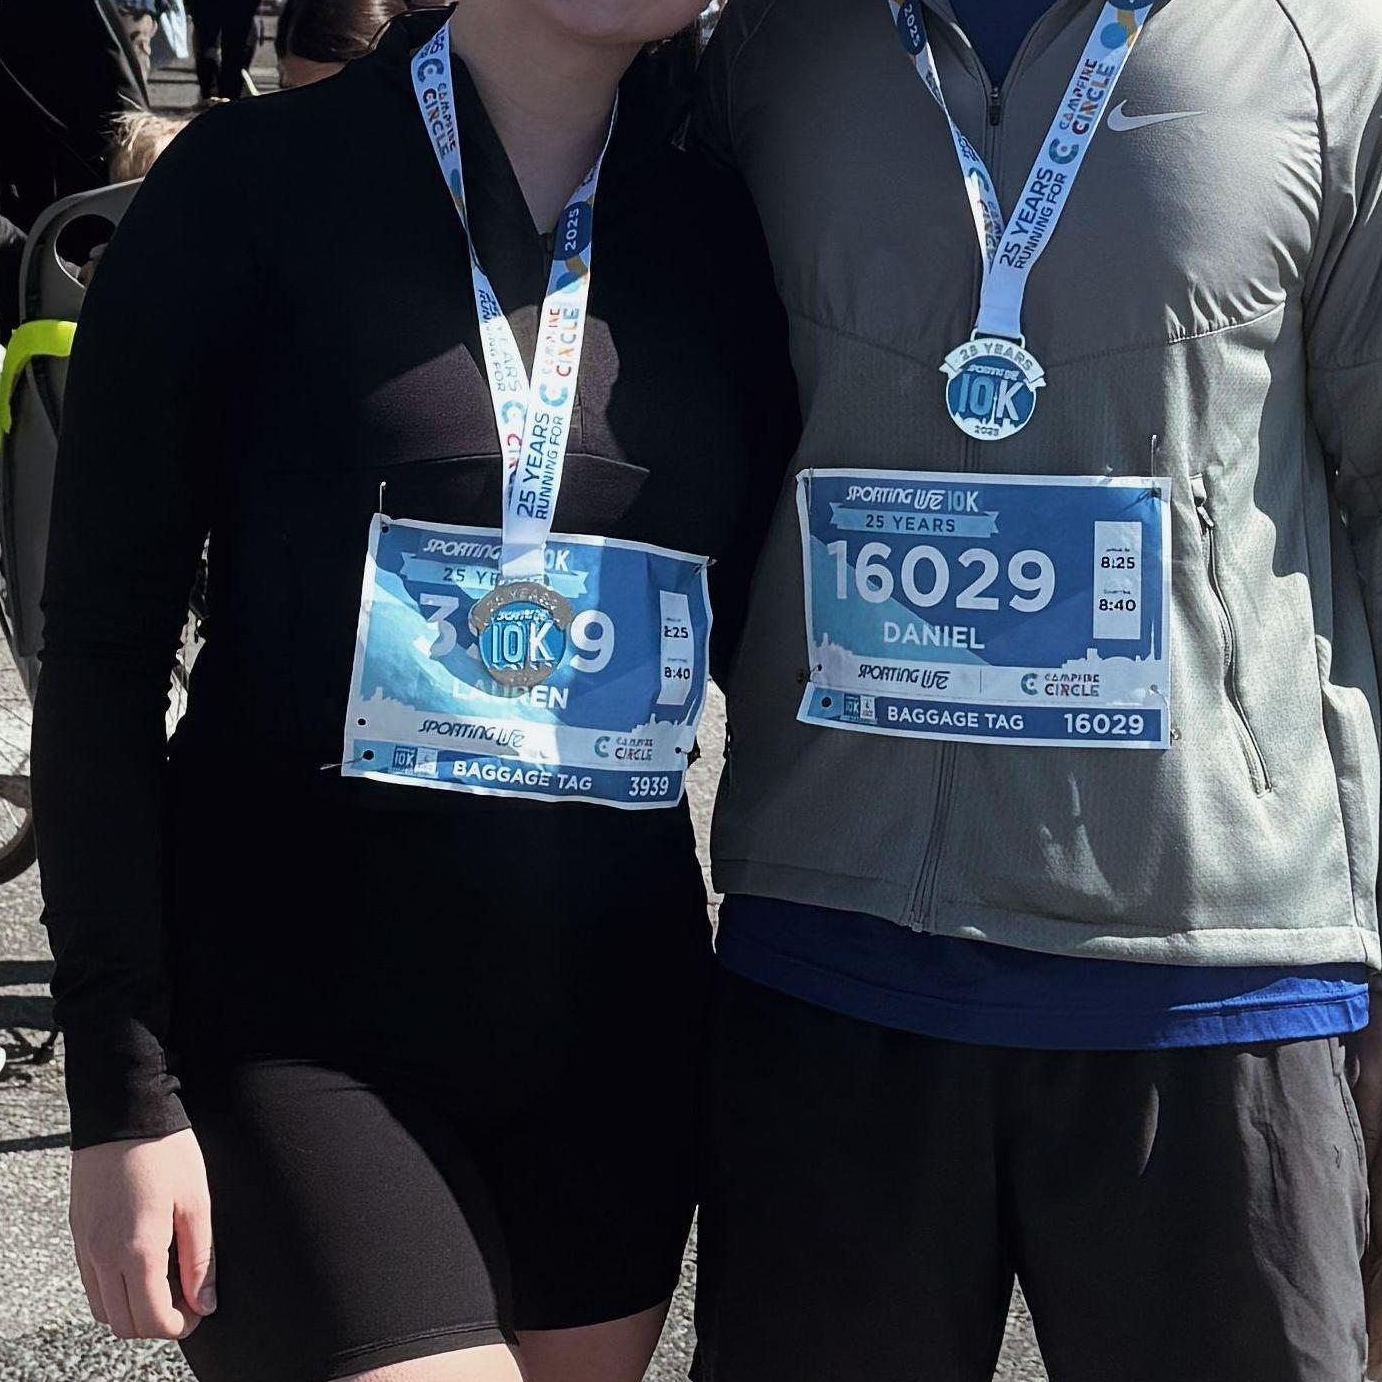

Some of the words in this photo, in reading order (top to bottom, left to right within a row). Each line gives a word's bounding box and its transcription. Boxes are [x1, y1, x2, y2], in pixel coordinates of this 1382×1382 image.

[1072, 63, 1116, 135] CIRCLE
[1010, 167, 1054, 237] YEARS
[564, 208, 579, 251] 2025
[1013, 206, 1054, 269] RUNNING
[1046, 172, 1067, 205] FOR
[999, 240, 1022, 267] 25
[958, 373, 1024, 421] 10K
[523, 412, 550, 485] YEARS
[535, 449, 558, 519] RUNNING
[549, 416, 564, 446] FOR
[517, 490, 536, 518] 25
[947, 490, 979, 513] 10K
[865, 514, 884, 528] 25
[892, 516, 956, 533] YEARS
[544, 549, 570, 571] 0K
[1100, 556, 1135, 570] 8:25
[443, 567, 465, 582] 25
[826, 539, 1056, 613] 16029
[1098, 598, 1136, 612] 8:40
[420, 592, 615, 674] 39
[491, 620, 556, 664] 10K
[883, 621, 985, 650] DANIEL
[1044, 683, 1100, 697] CIRCLE
[887, 706, 979, 728] BAGGAGE
[984, 713, 1024, 730] TAG
[1064, 713, 1144, 735] 16029
[452, 760, 550, 787] BAGGAGE
[557, 774, 593, 791] TAG
[628, 776, 669, 797] 3939
